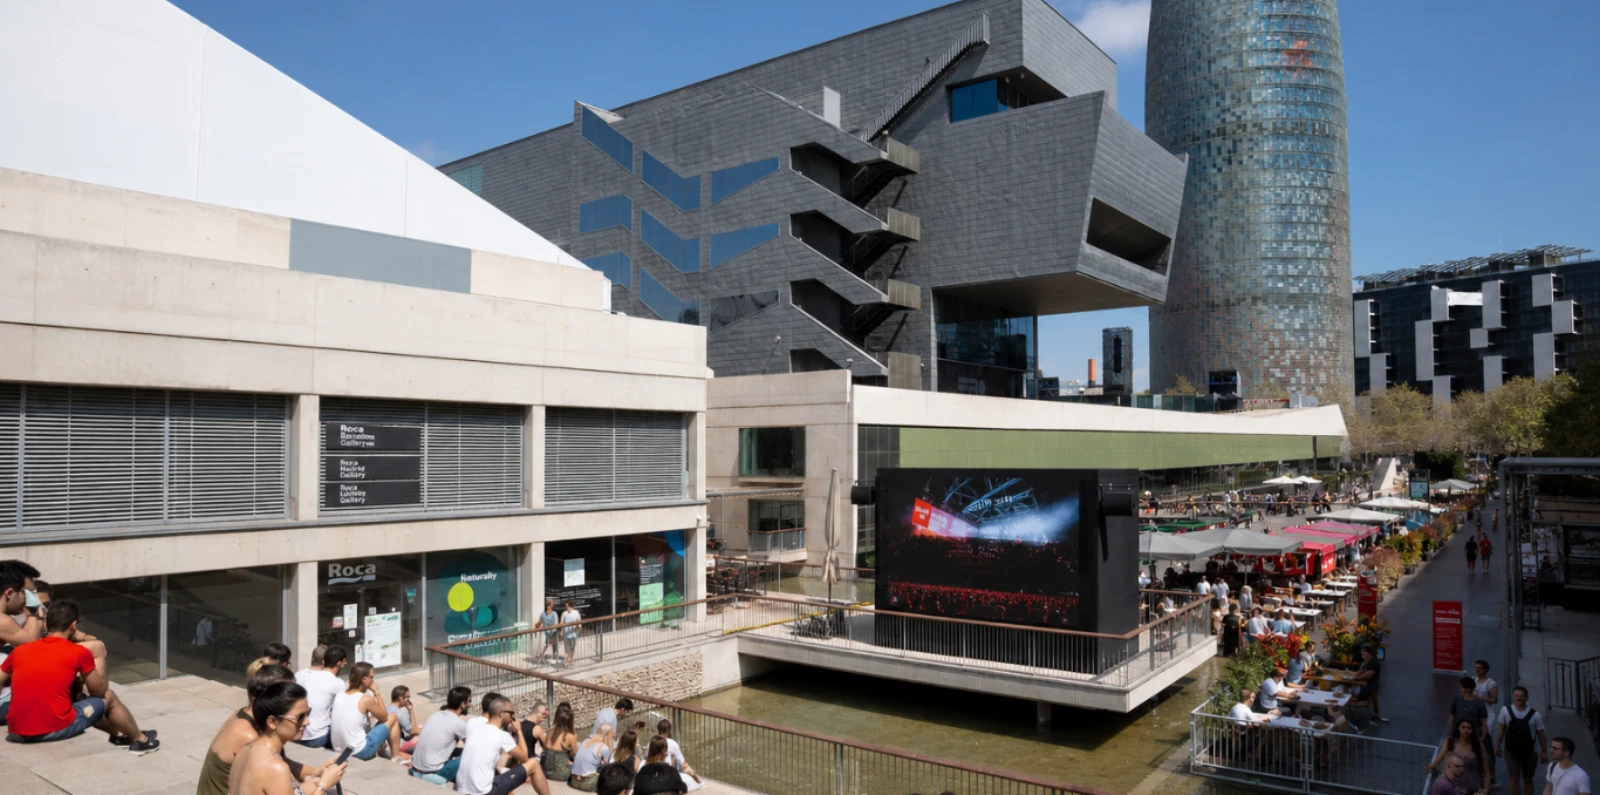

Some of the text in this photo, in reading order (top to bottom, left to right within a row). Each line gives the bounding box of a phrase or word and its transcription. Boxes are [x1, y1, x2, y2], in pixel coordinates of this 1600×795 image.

[340, 424, 364, 433] Roca
[328, 564, 376, 578] Roca
[460, 571, 497, 582] Naturally
